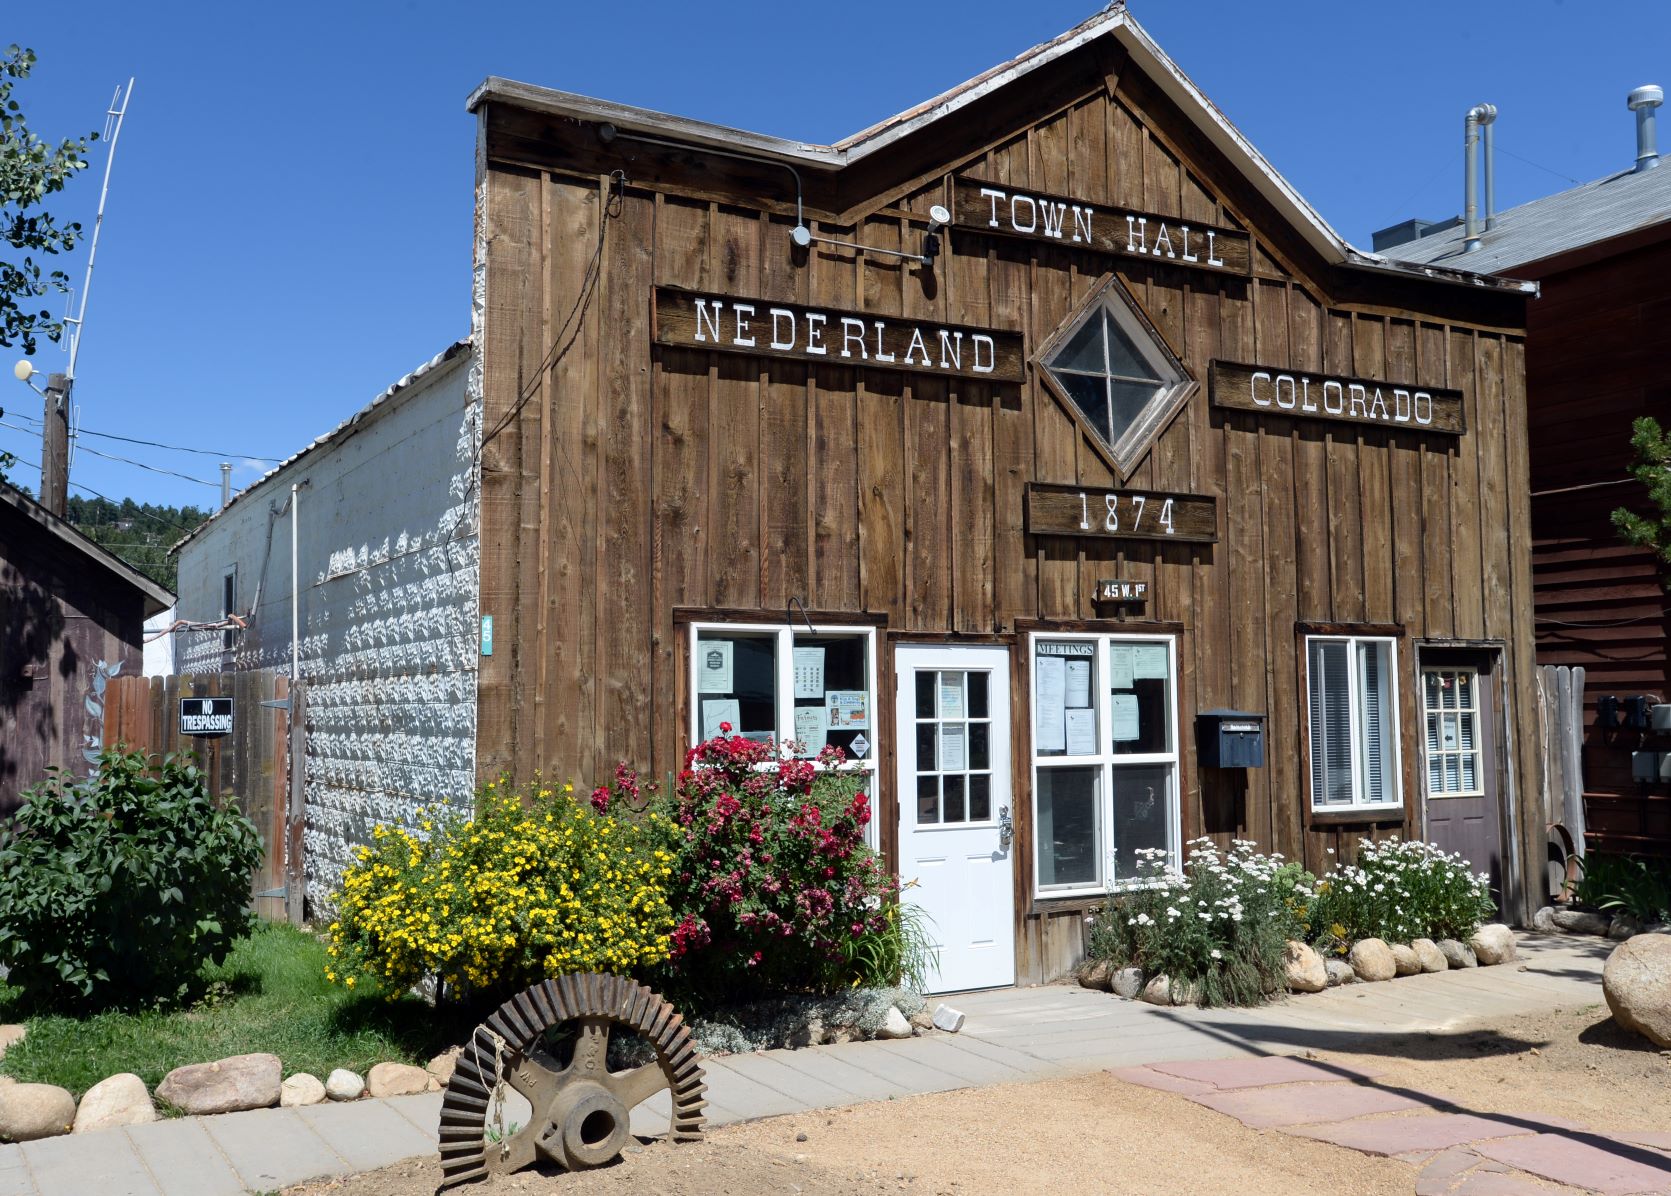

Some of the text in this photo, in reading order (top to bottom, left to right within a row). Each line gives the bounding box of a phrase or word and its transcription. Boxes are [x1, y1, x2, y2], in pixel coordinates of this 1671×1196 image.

[980, 188, 1223, 267] TOWN HALL
[694, 298, 995, 373] NEDERLAND
[1251, 372, 1432, 425] COLORADO
[1079, 492, 1175, 534] 1874
[1103, 584, 1146, 598] 45 W. 1ST
[483, 619, 491, 642] 45
[1038, 643, 1093, 655] MEETINGS
[202, 700, 213, 715] NO
[182, 715, 232, 730] TRESPASSING
